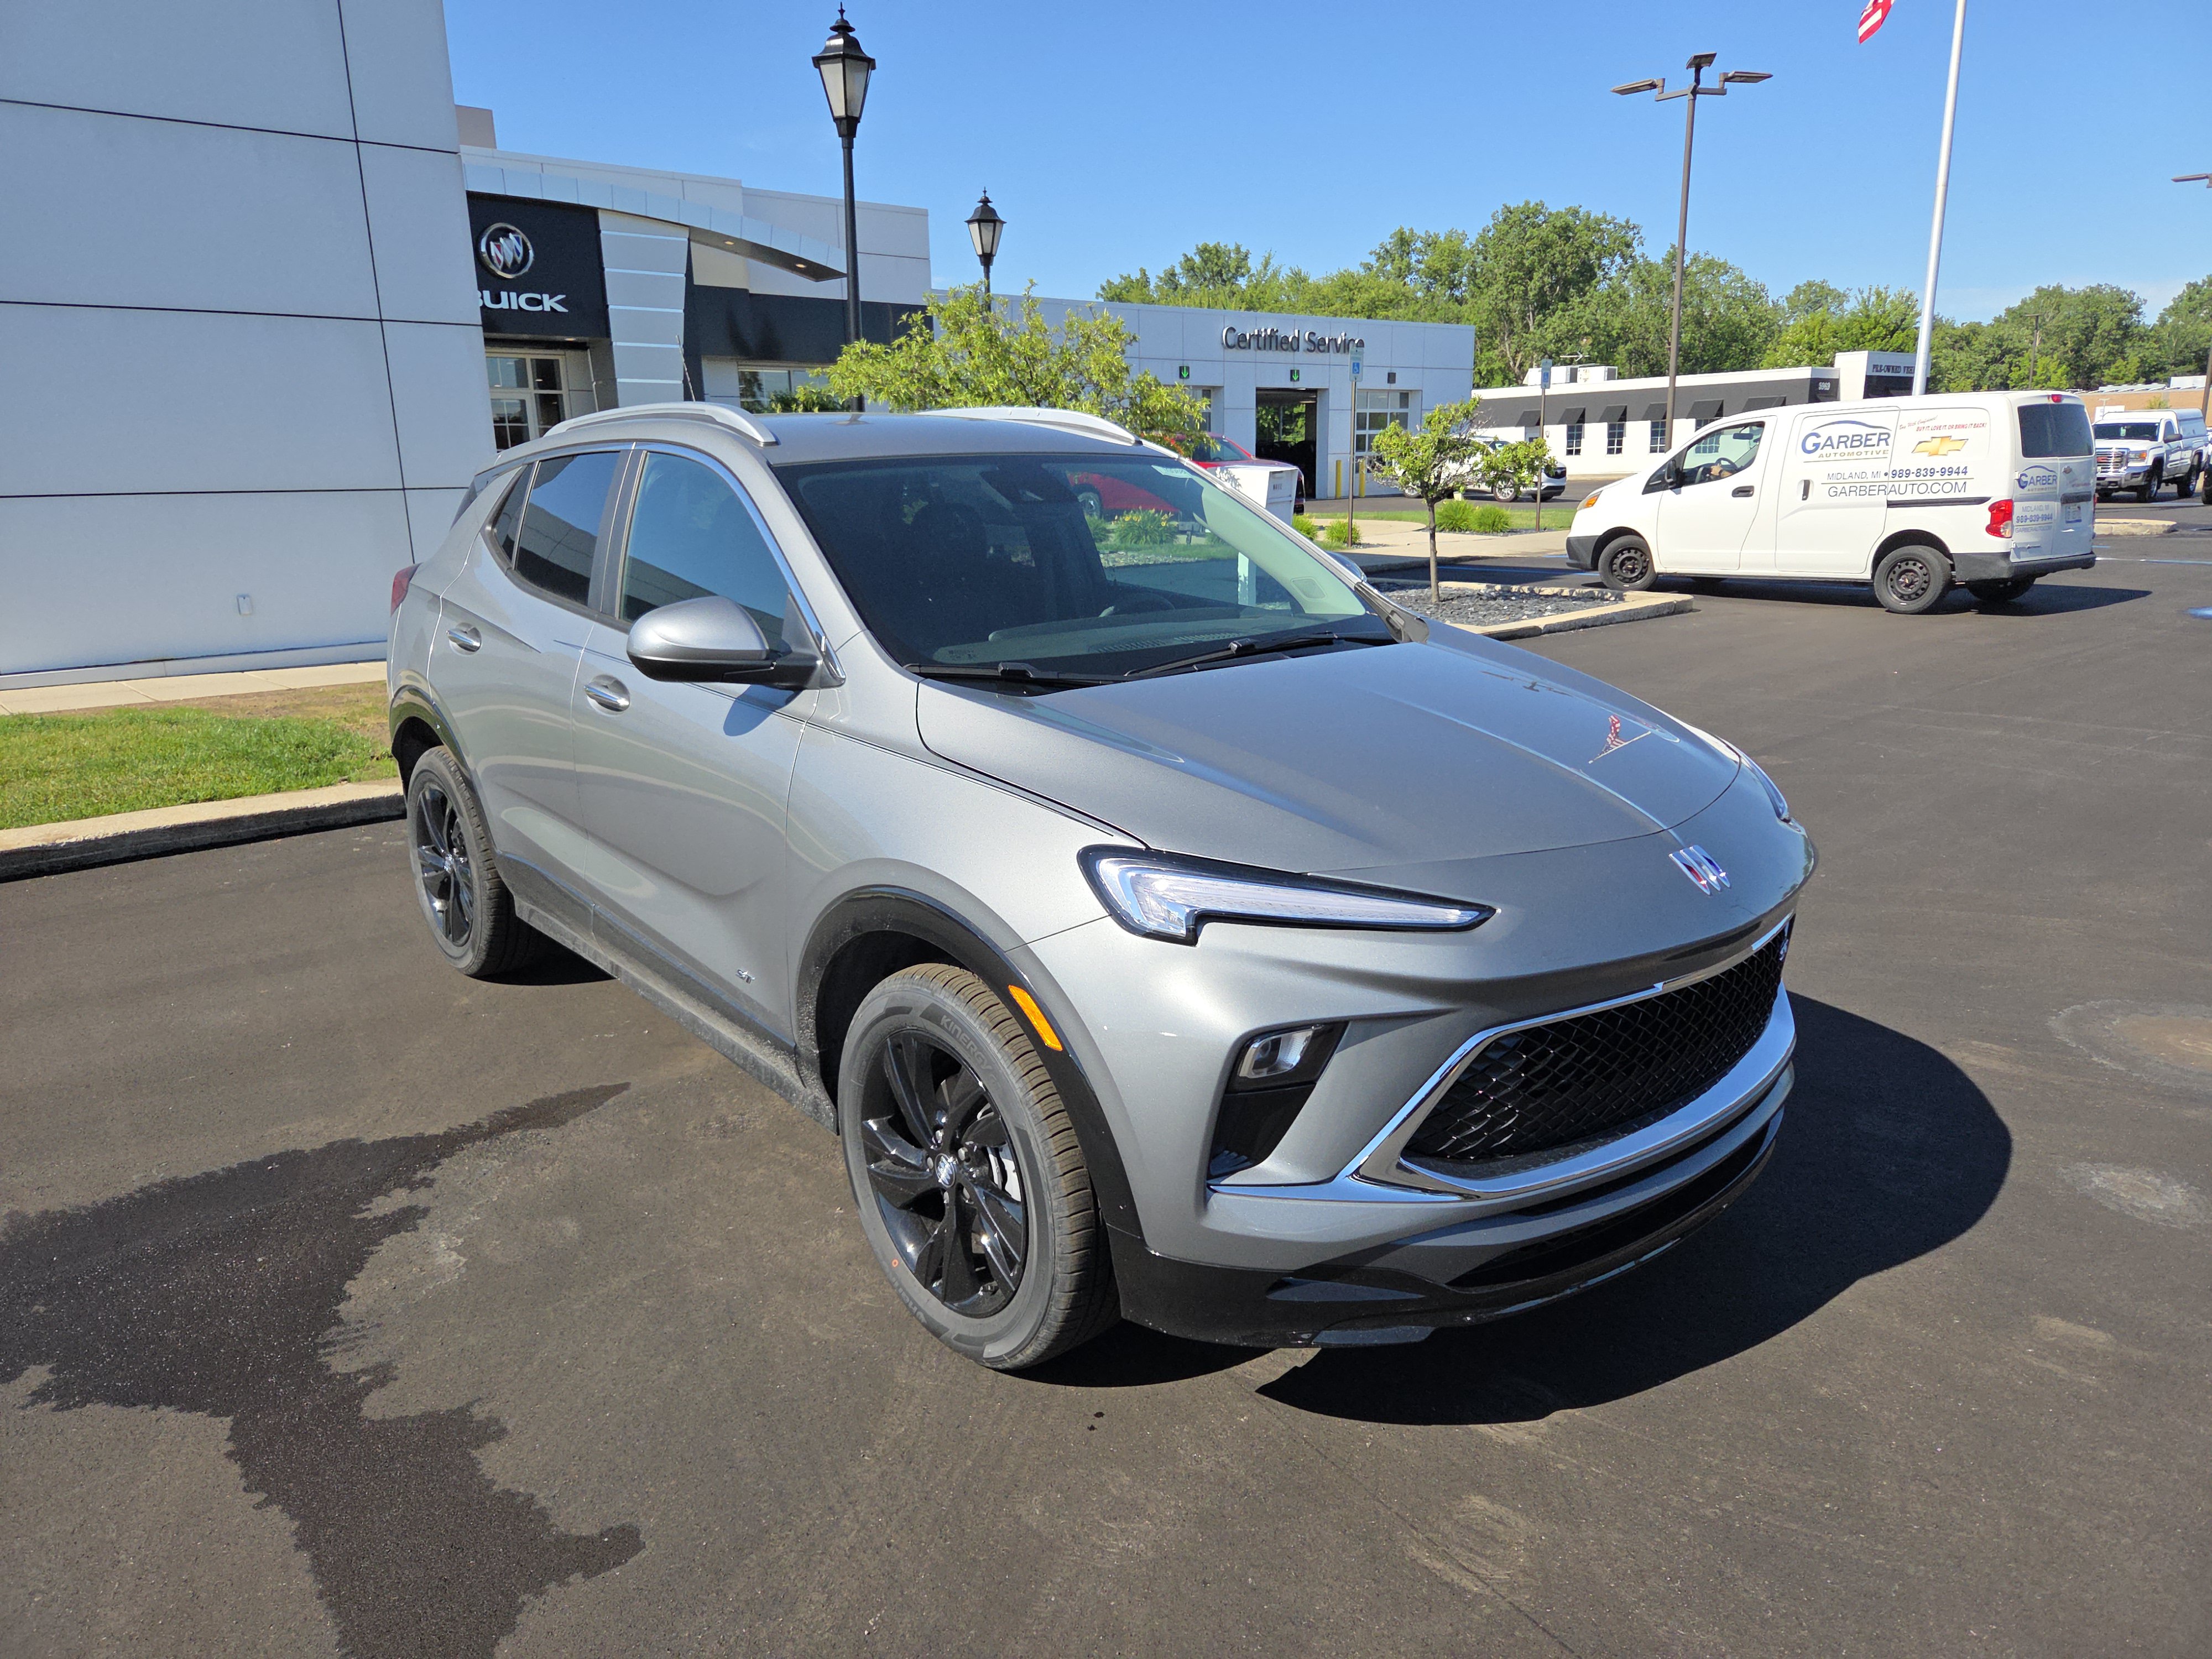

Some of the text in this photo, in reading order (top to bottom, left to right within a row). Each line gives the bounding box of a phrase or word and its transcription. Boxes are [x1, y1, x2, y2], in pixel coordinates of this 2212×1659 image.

[1222, 326, 1300, 352] Certified
[1802, 432, 1891, 454] GARBER
[1818, 450, 1889, 458] AUTOMOTIVE
[1827, 471, 1869, 480] MIDLAND,
[1891, 466, 1968, 478] 989-839-9944
[2018, 473, 2057, 489] GARBER
[1828, 481, 1967, 497] GARBERAUTO.COM
[940, 1015, 992, 1070] KINERGY
